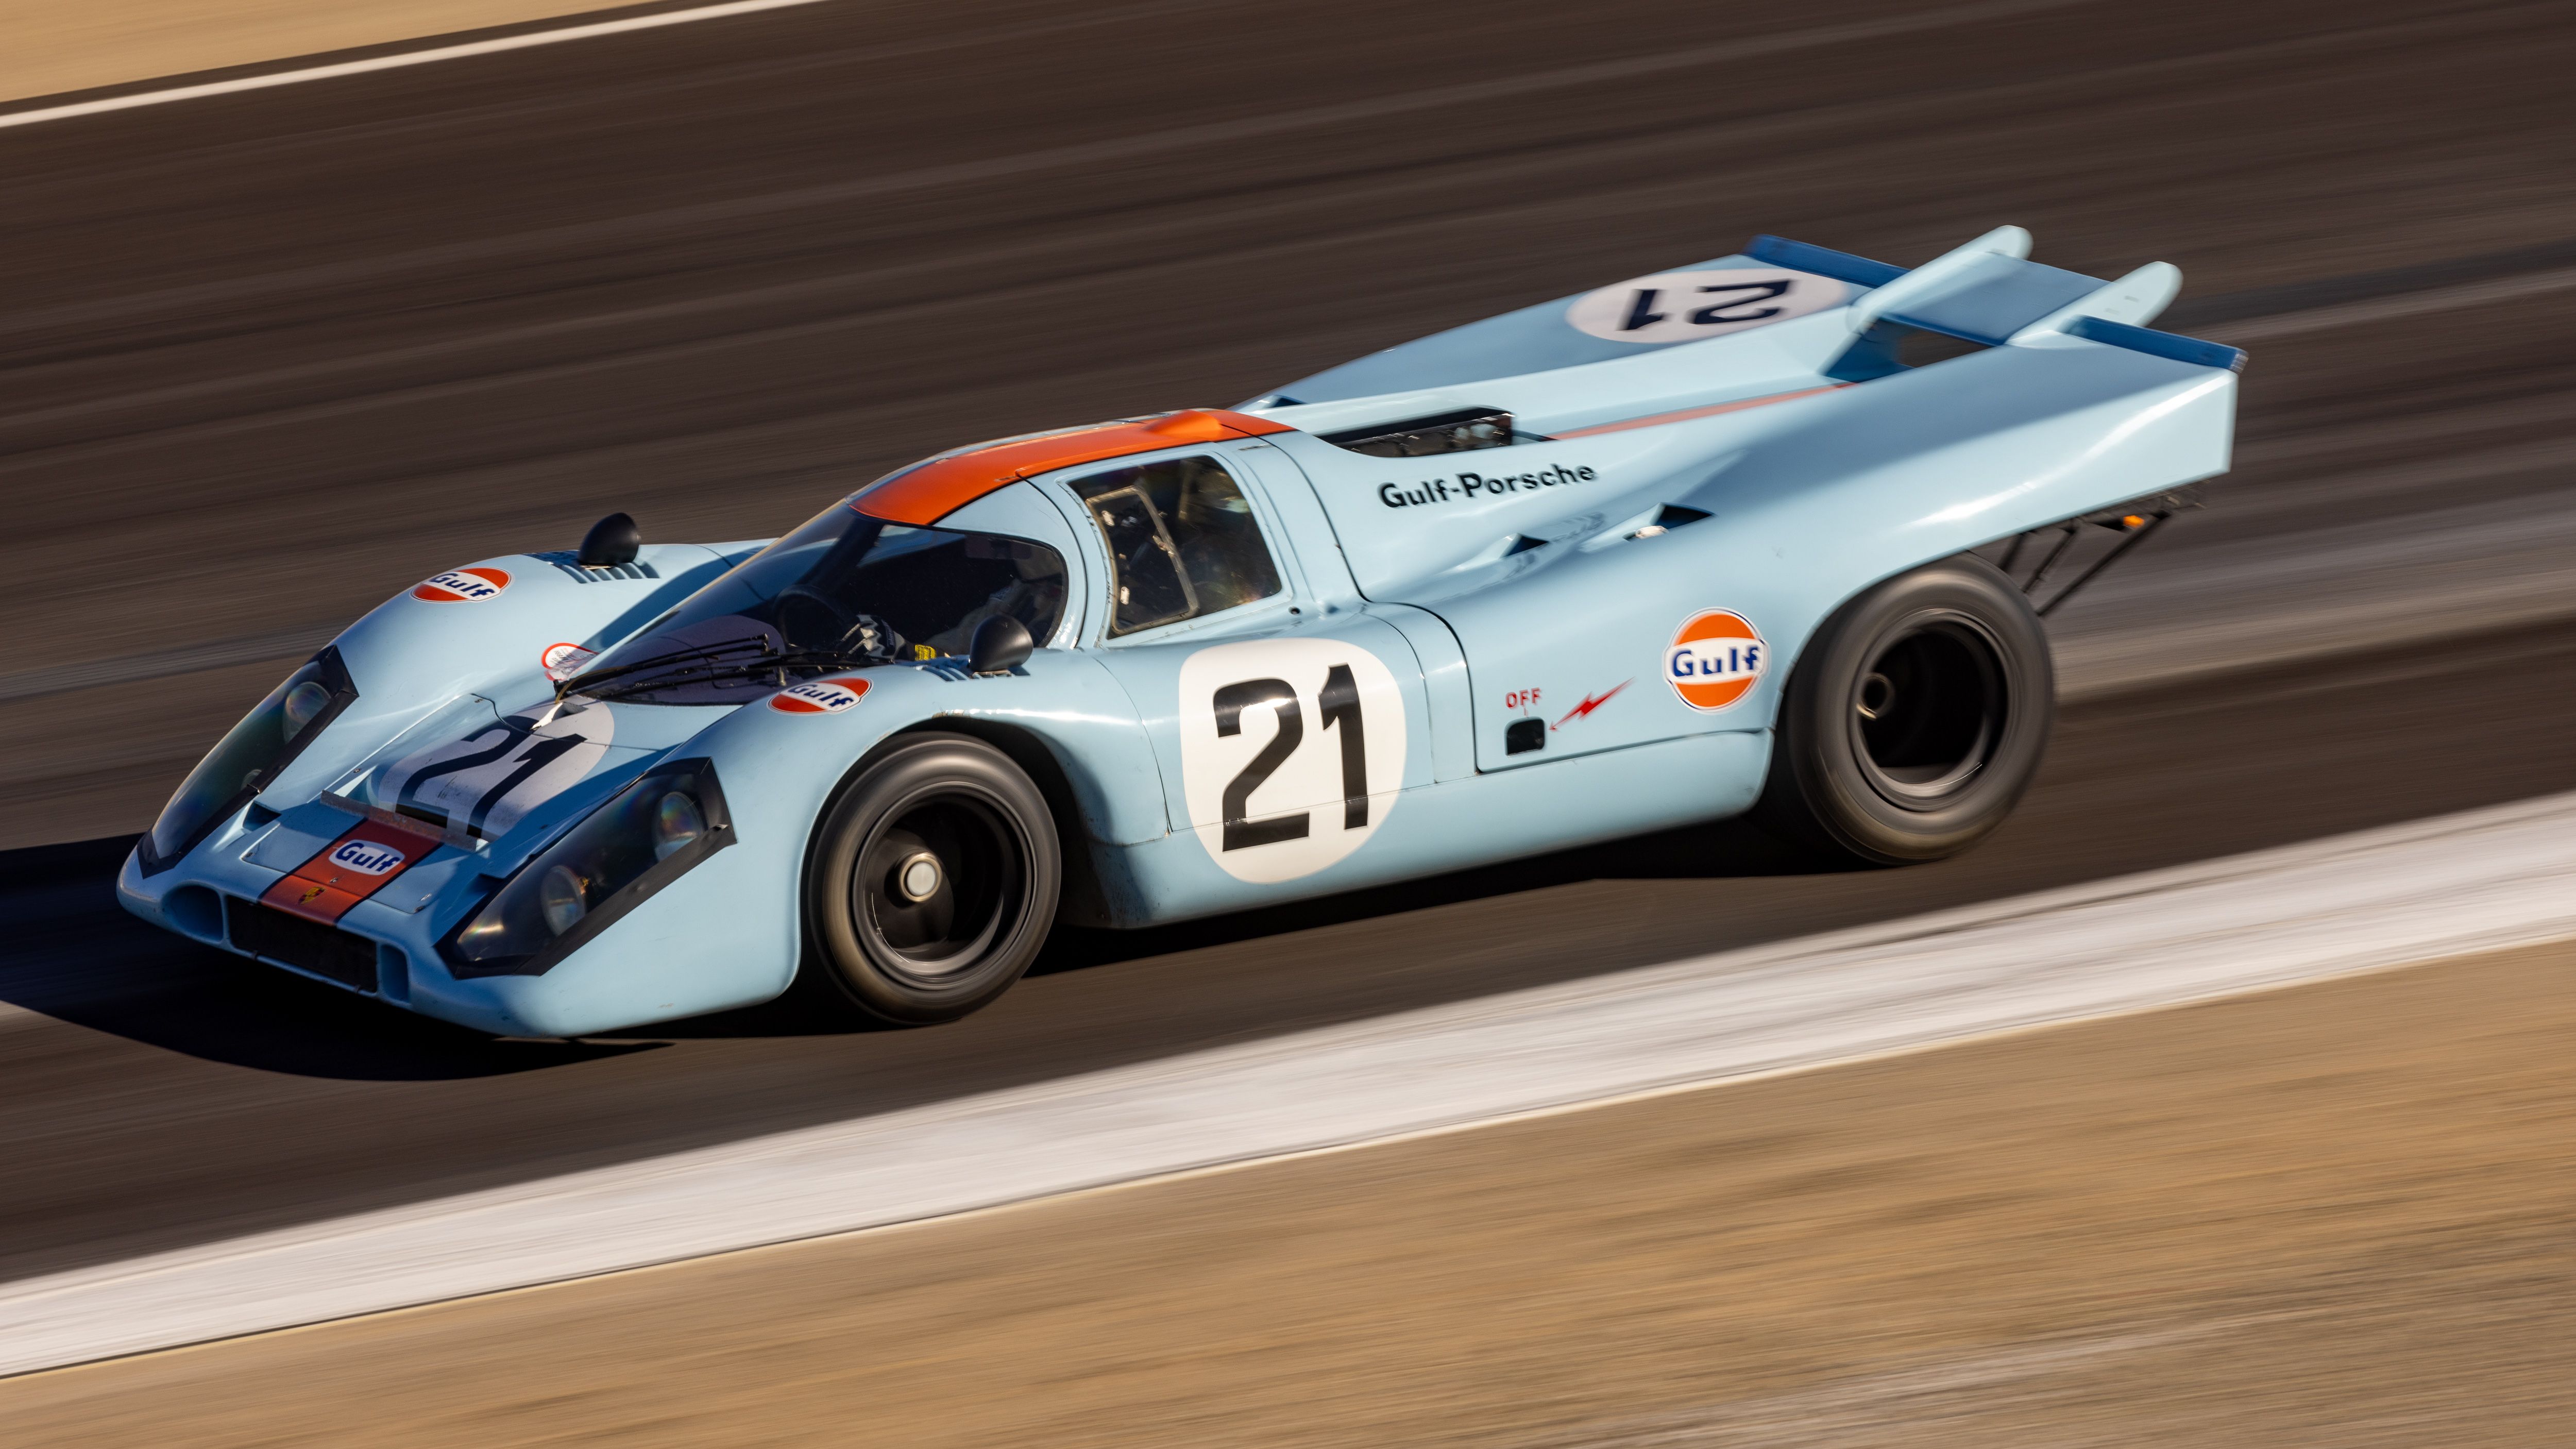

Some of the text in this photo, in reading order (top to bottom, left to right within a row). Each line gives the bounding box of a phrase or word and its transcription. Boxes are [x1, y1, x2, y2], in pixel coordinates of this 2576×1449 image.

[1617, 278, 1797, 331] 21
[1377, 463, 1596, 508] Gulf-Porsche
[429, 573, 495, 597] Gulf
[1672, 645, 1759, 677] Gulf
[788, 684, 854, 707] Gulf
[1505, 687, 1541, 709] OFF
[1213, 662, 1368, 852] 21
[395, 715, 587, 838] 21
[335, 843, 400, 872] Gulf
